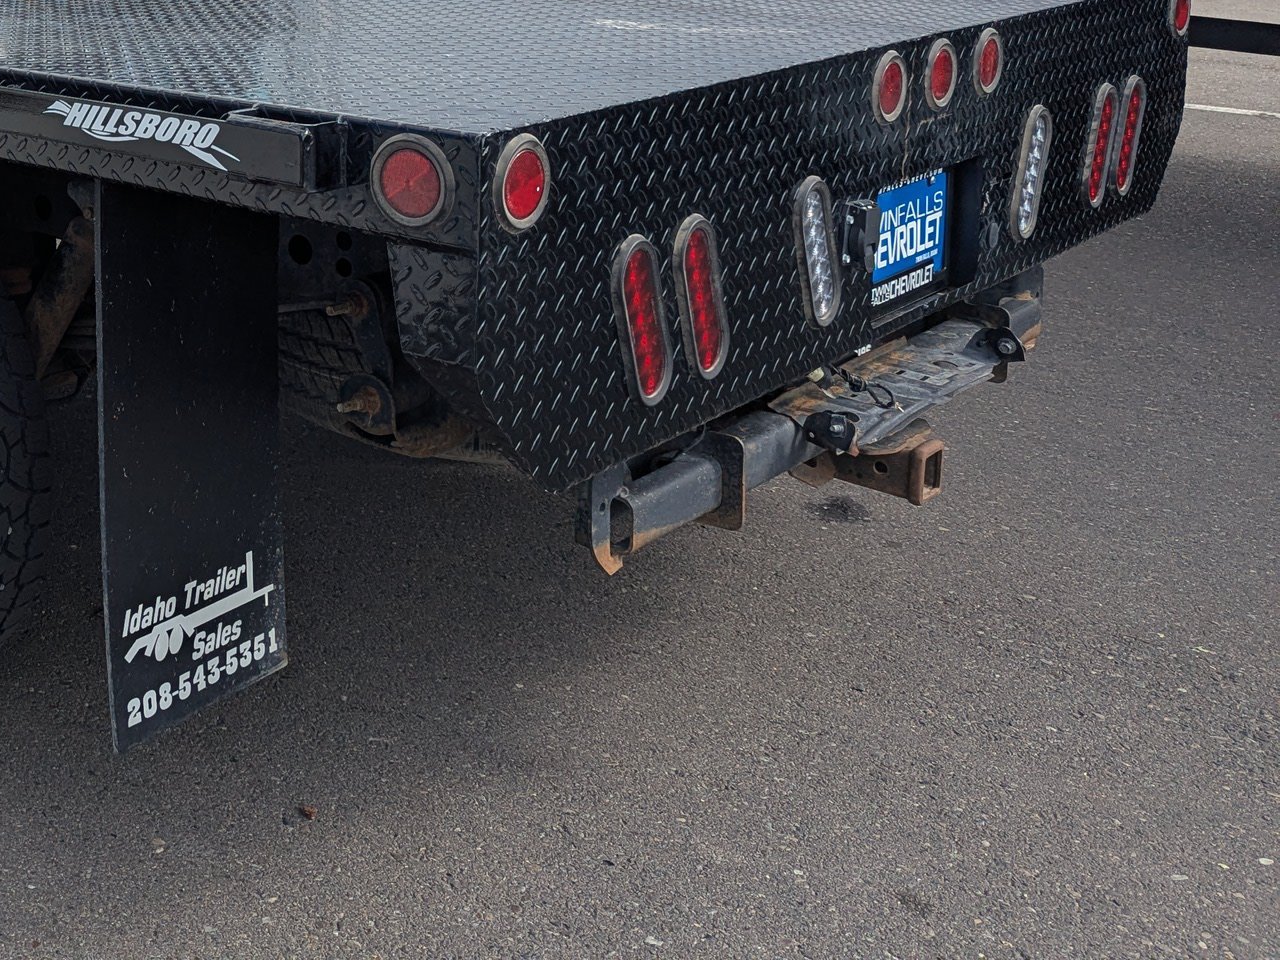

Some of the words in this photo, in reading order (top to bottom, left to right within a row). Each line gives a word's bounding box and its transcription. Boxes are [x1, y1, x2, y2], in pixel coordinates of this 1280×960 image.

[63, 102, 220, 149] HILLSBORO
[889, 263, 934, 300] CHEVROLET
[122, 595, 177, 638] Idaho
[184, 562, 248, 610] Trailer
[191, 619, 243, 661] Sales
[126, 626, 278, 729] 208-543-5351
